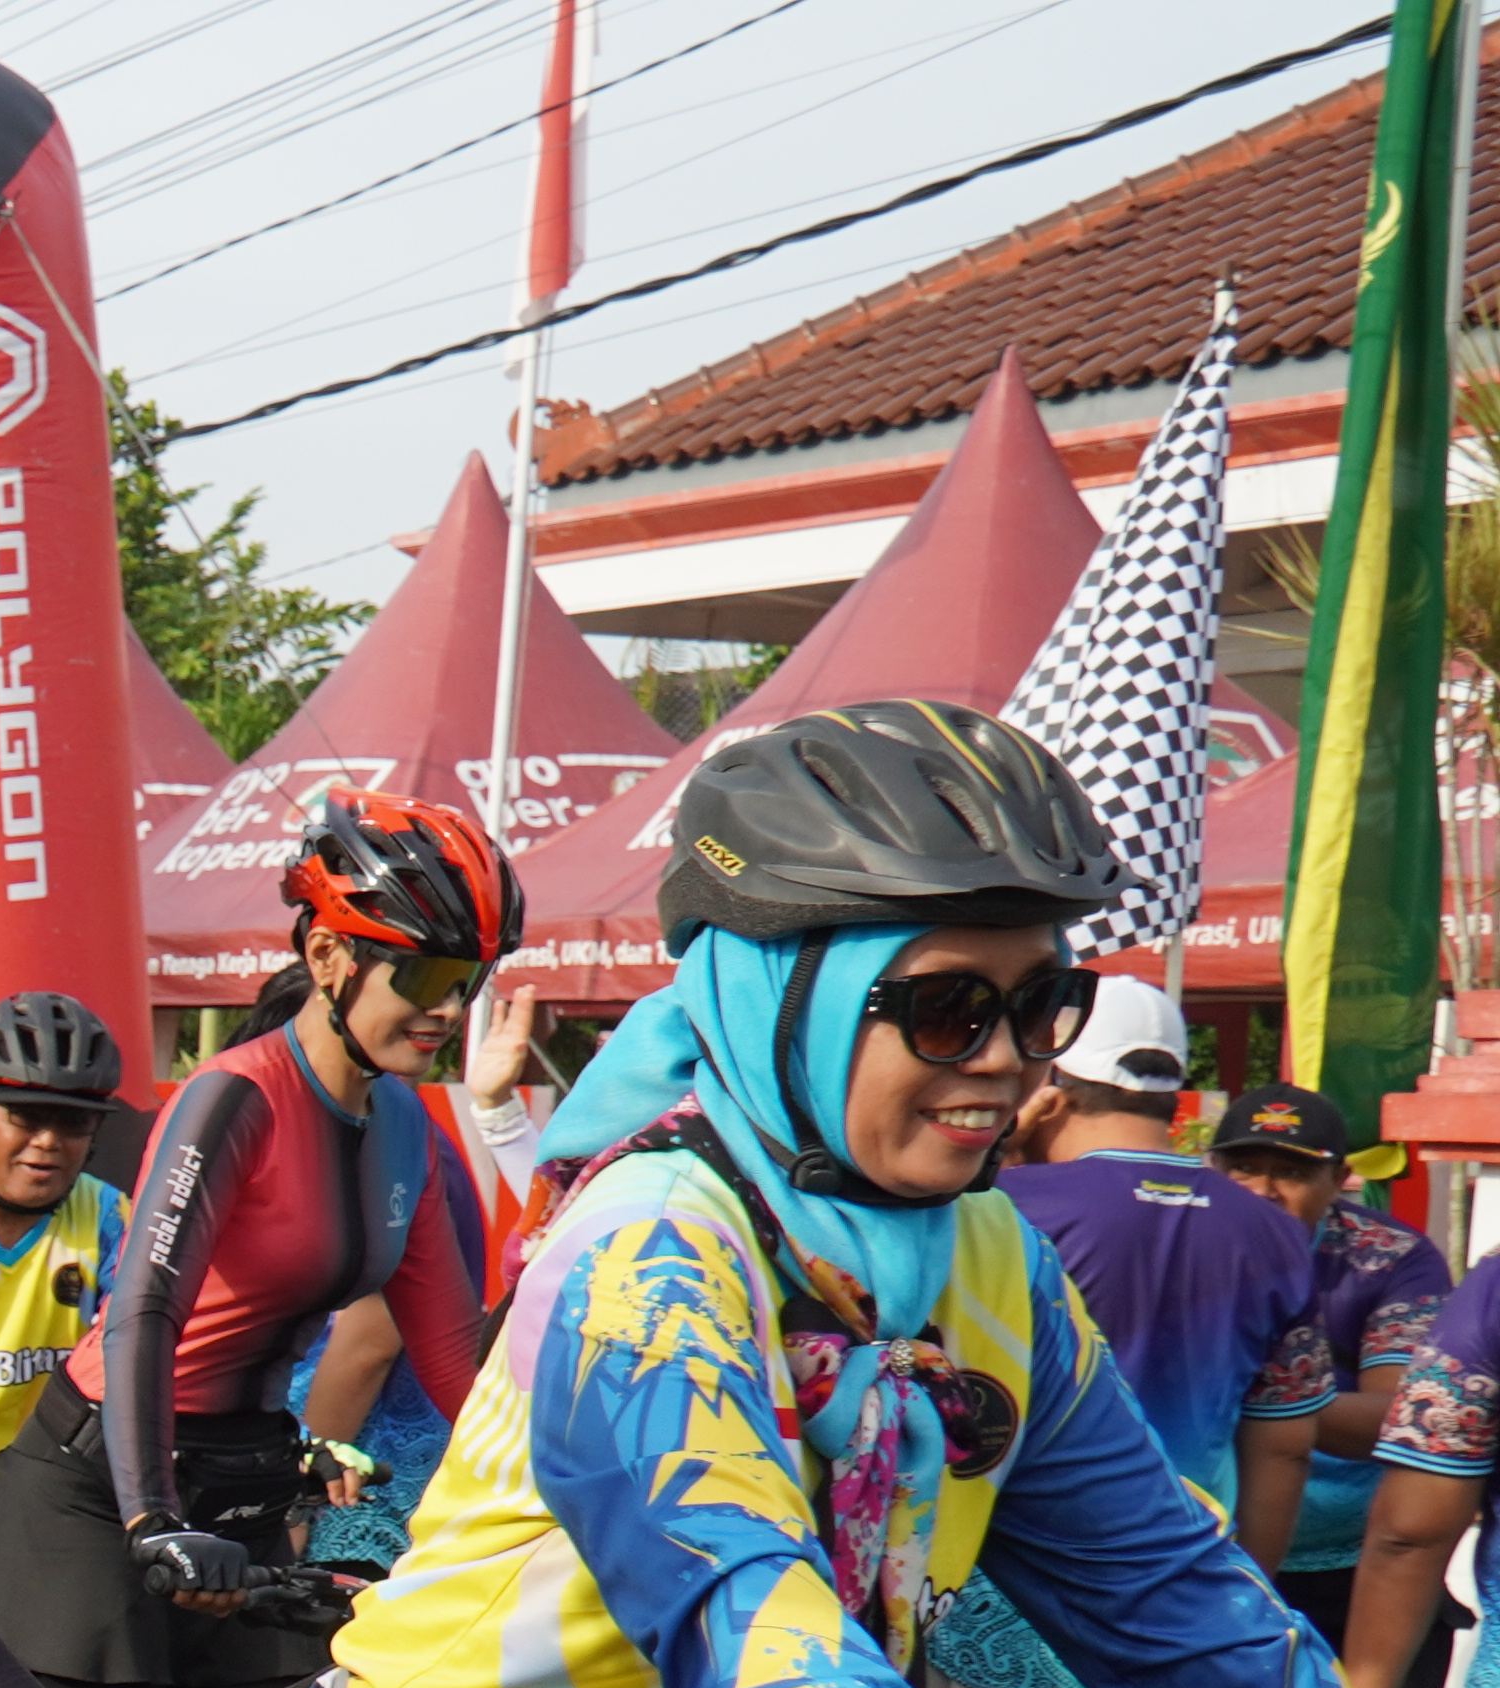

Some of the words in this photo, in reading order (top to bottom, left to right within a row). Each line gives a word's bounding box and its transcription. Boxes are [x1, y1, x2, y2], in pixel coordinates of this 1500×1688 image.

[189, 797, 272, 837] ber-
[153, 836, 303, 881] kopera
[1248, 917, 1286, 943] UK
[217, 948, 259, 979] Kerja
[148, 1211, 182, 1277] pedal
[165, 1144, 204, 1210] addict
